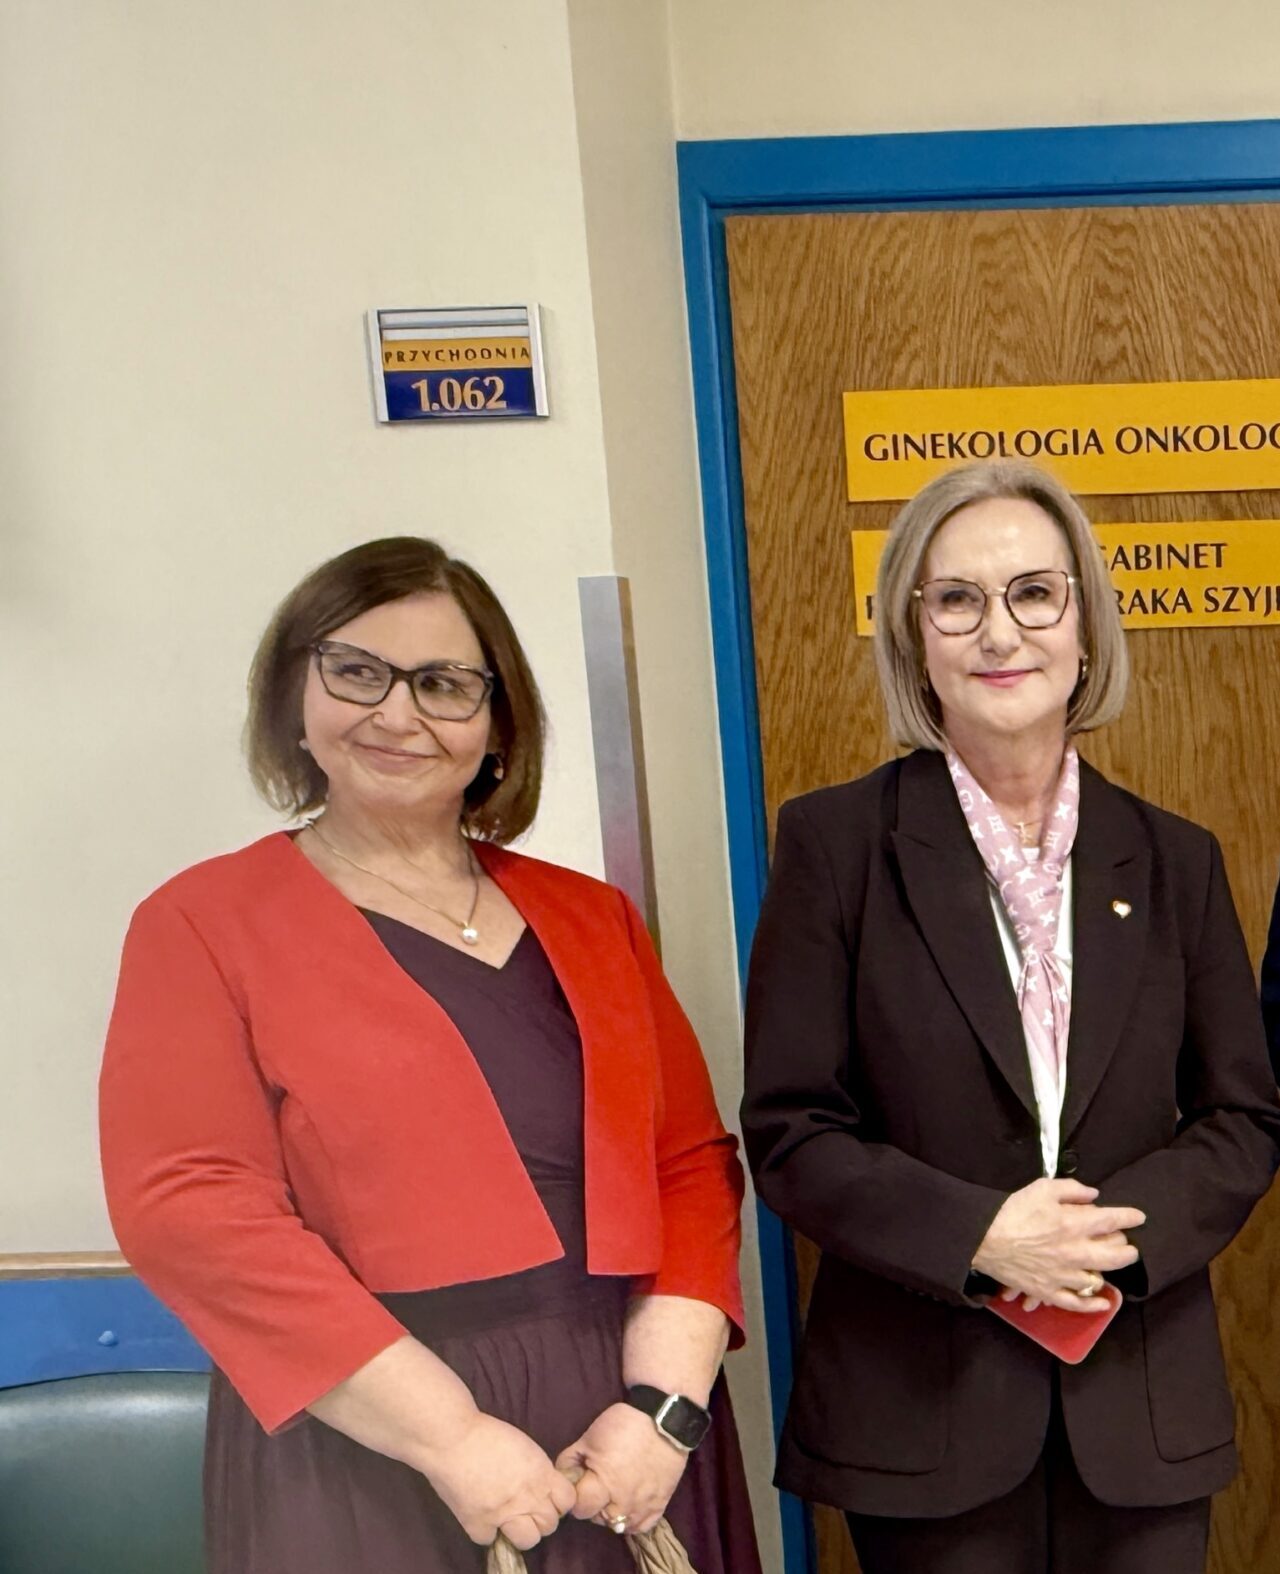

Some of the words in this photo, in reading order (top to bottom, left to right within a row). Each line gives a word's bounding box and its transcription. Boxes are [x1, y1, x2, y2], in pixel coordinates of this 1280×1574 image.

[384, 347, 530, 364] PRZYCHODNIA
[411, 376, 507, 412] 1.062
[863, 428, 1105, 461] GINEKOLOGIA
